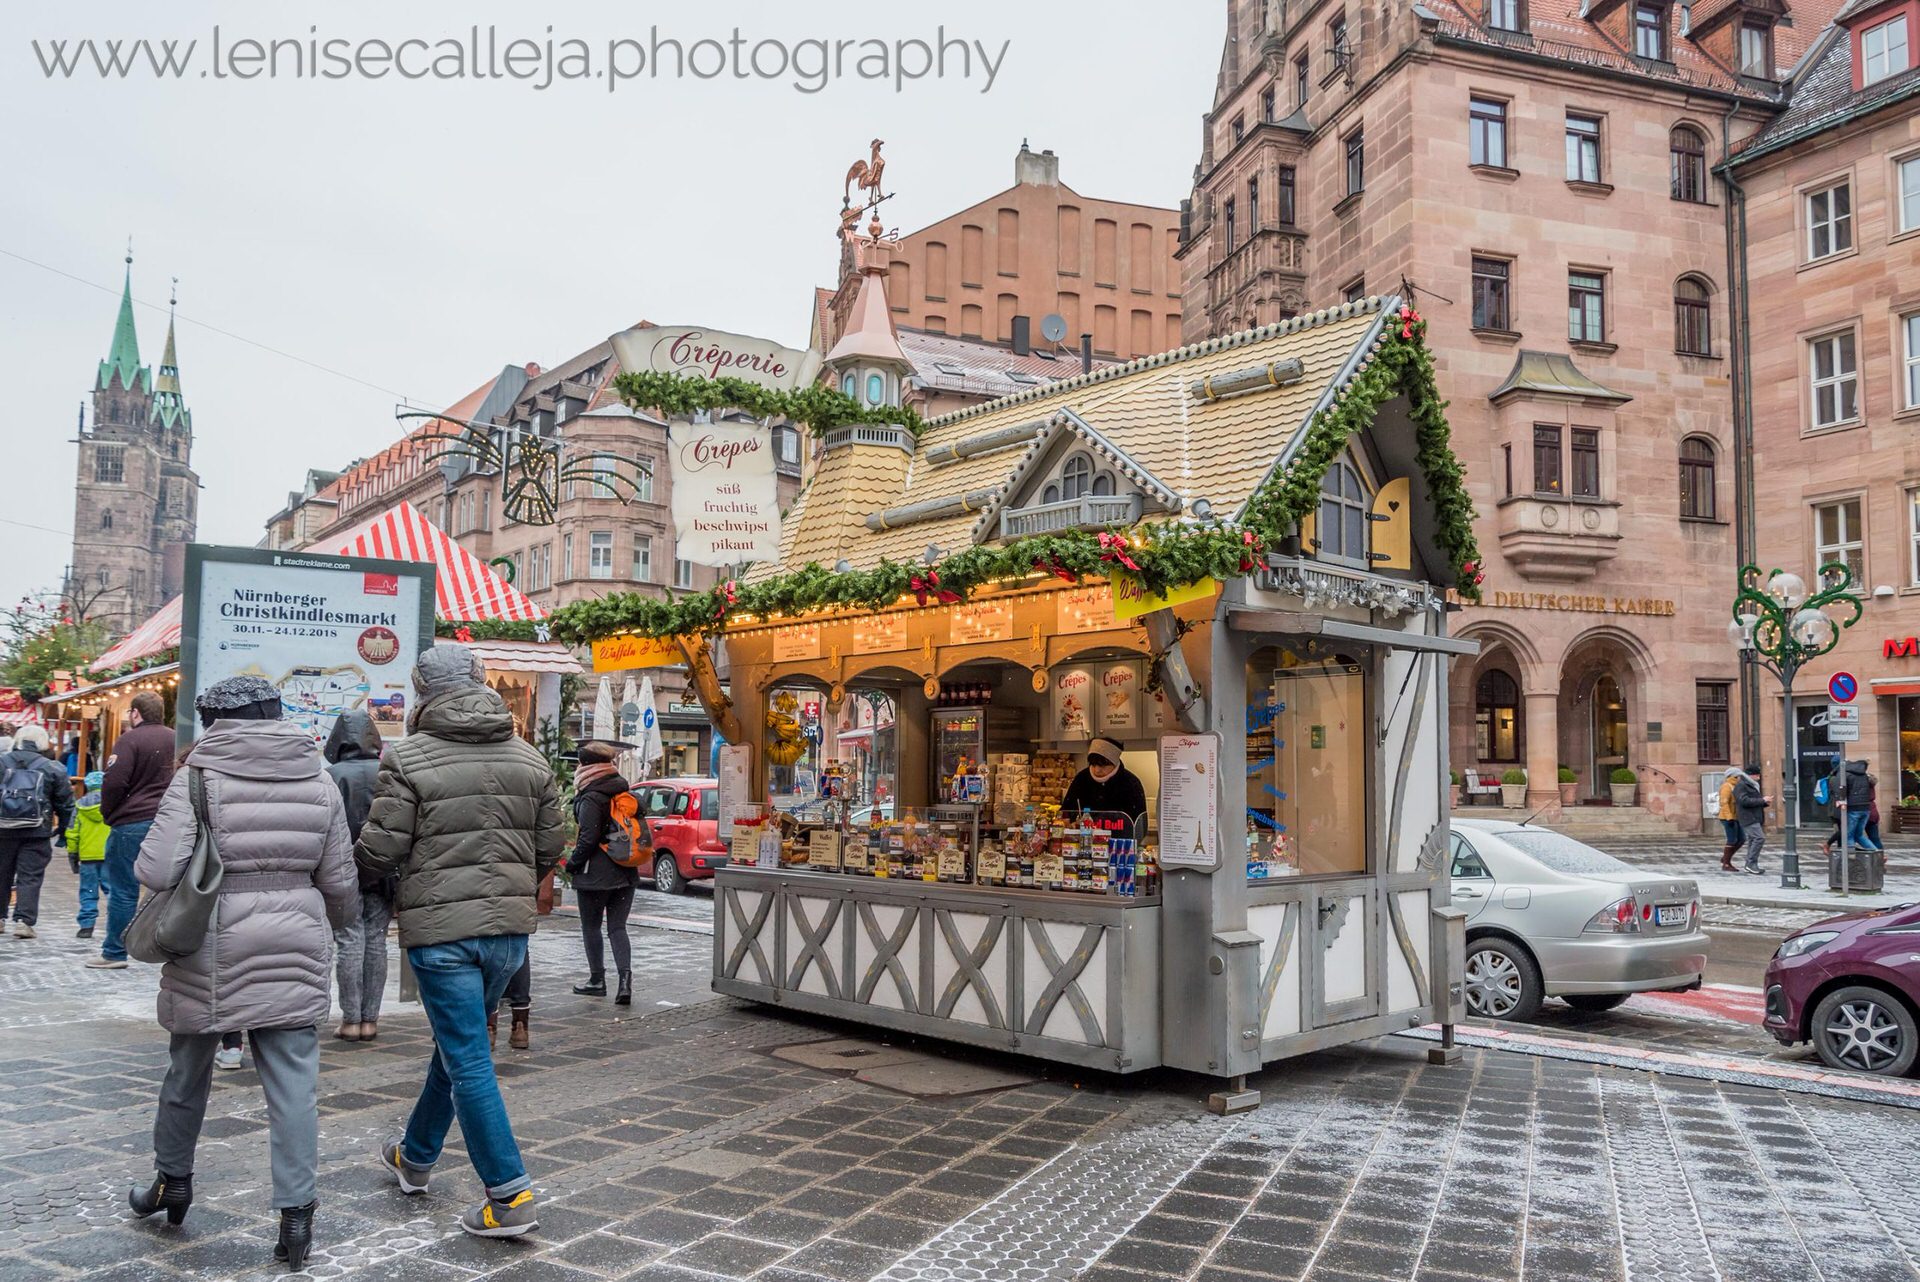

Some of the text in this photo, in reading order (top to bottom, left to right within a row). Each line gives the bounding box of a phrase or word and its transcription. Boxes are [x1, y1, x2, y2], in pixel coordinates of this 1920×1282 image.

[650, 331, 789, 380] Crêperie
[680, 434, 763, 473] Crêpes
[716, 483, 741, 495] süß
[704, 500, 758, 516] fruchtig
[694, 519, 768, 535] beschwipst
[711, 538, 754, 553] pikant
[283, 558, 351, 570] stadtreklame.com
[233, 588, 328, 607] Nürnberger
[1494, 591, 1607, 612] DEUTSCHER
[1614, 596, 1676, 616] KAISER
[220, 602, 397, 626] Christkindlesmarkt
[600, 643, 636, 662] Waffeln
[1058, 674, 1086, 690] Crêpes
[1103, 671, 1133, 687] Crêpes
[1104, 819, 1124, 831] Bull
